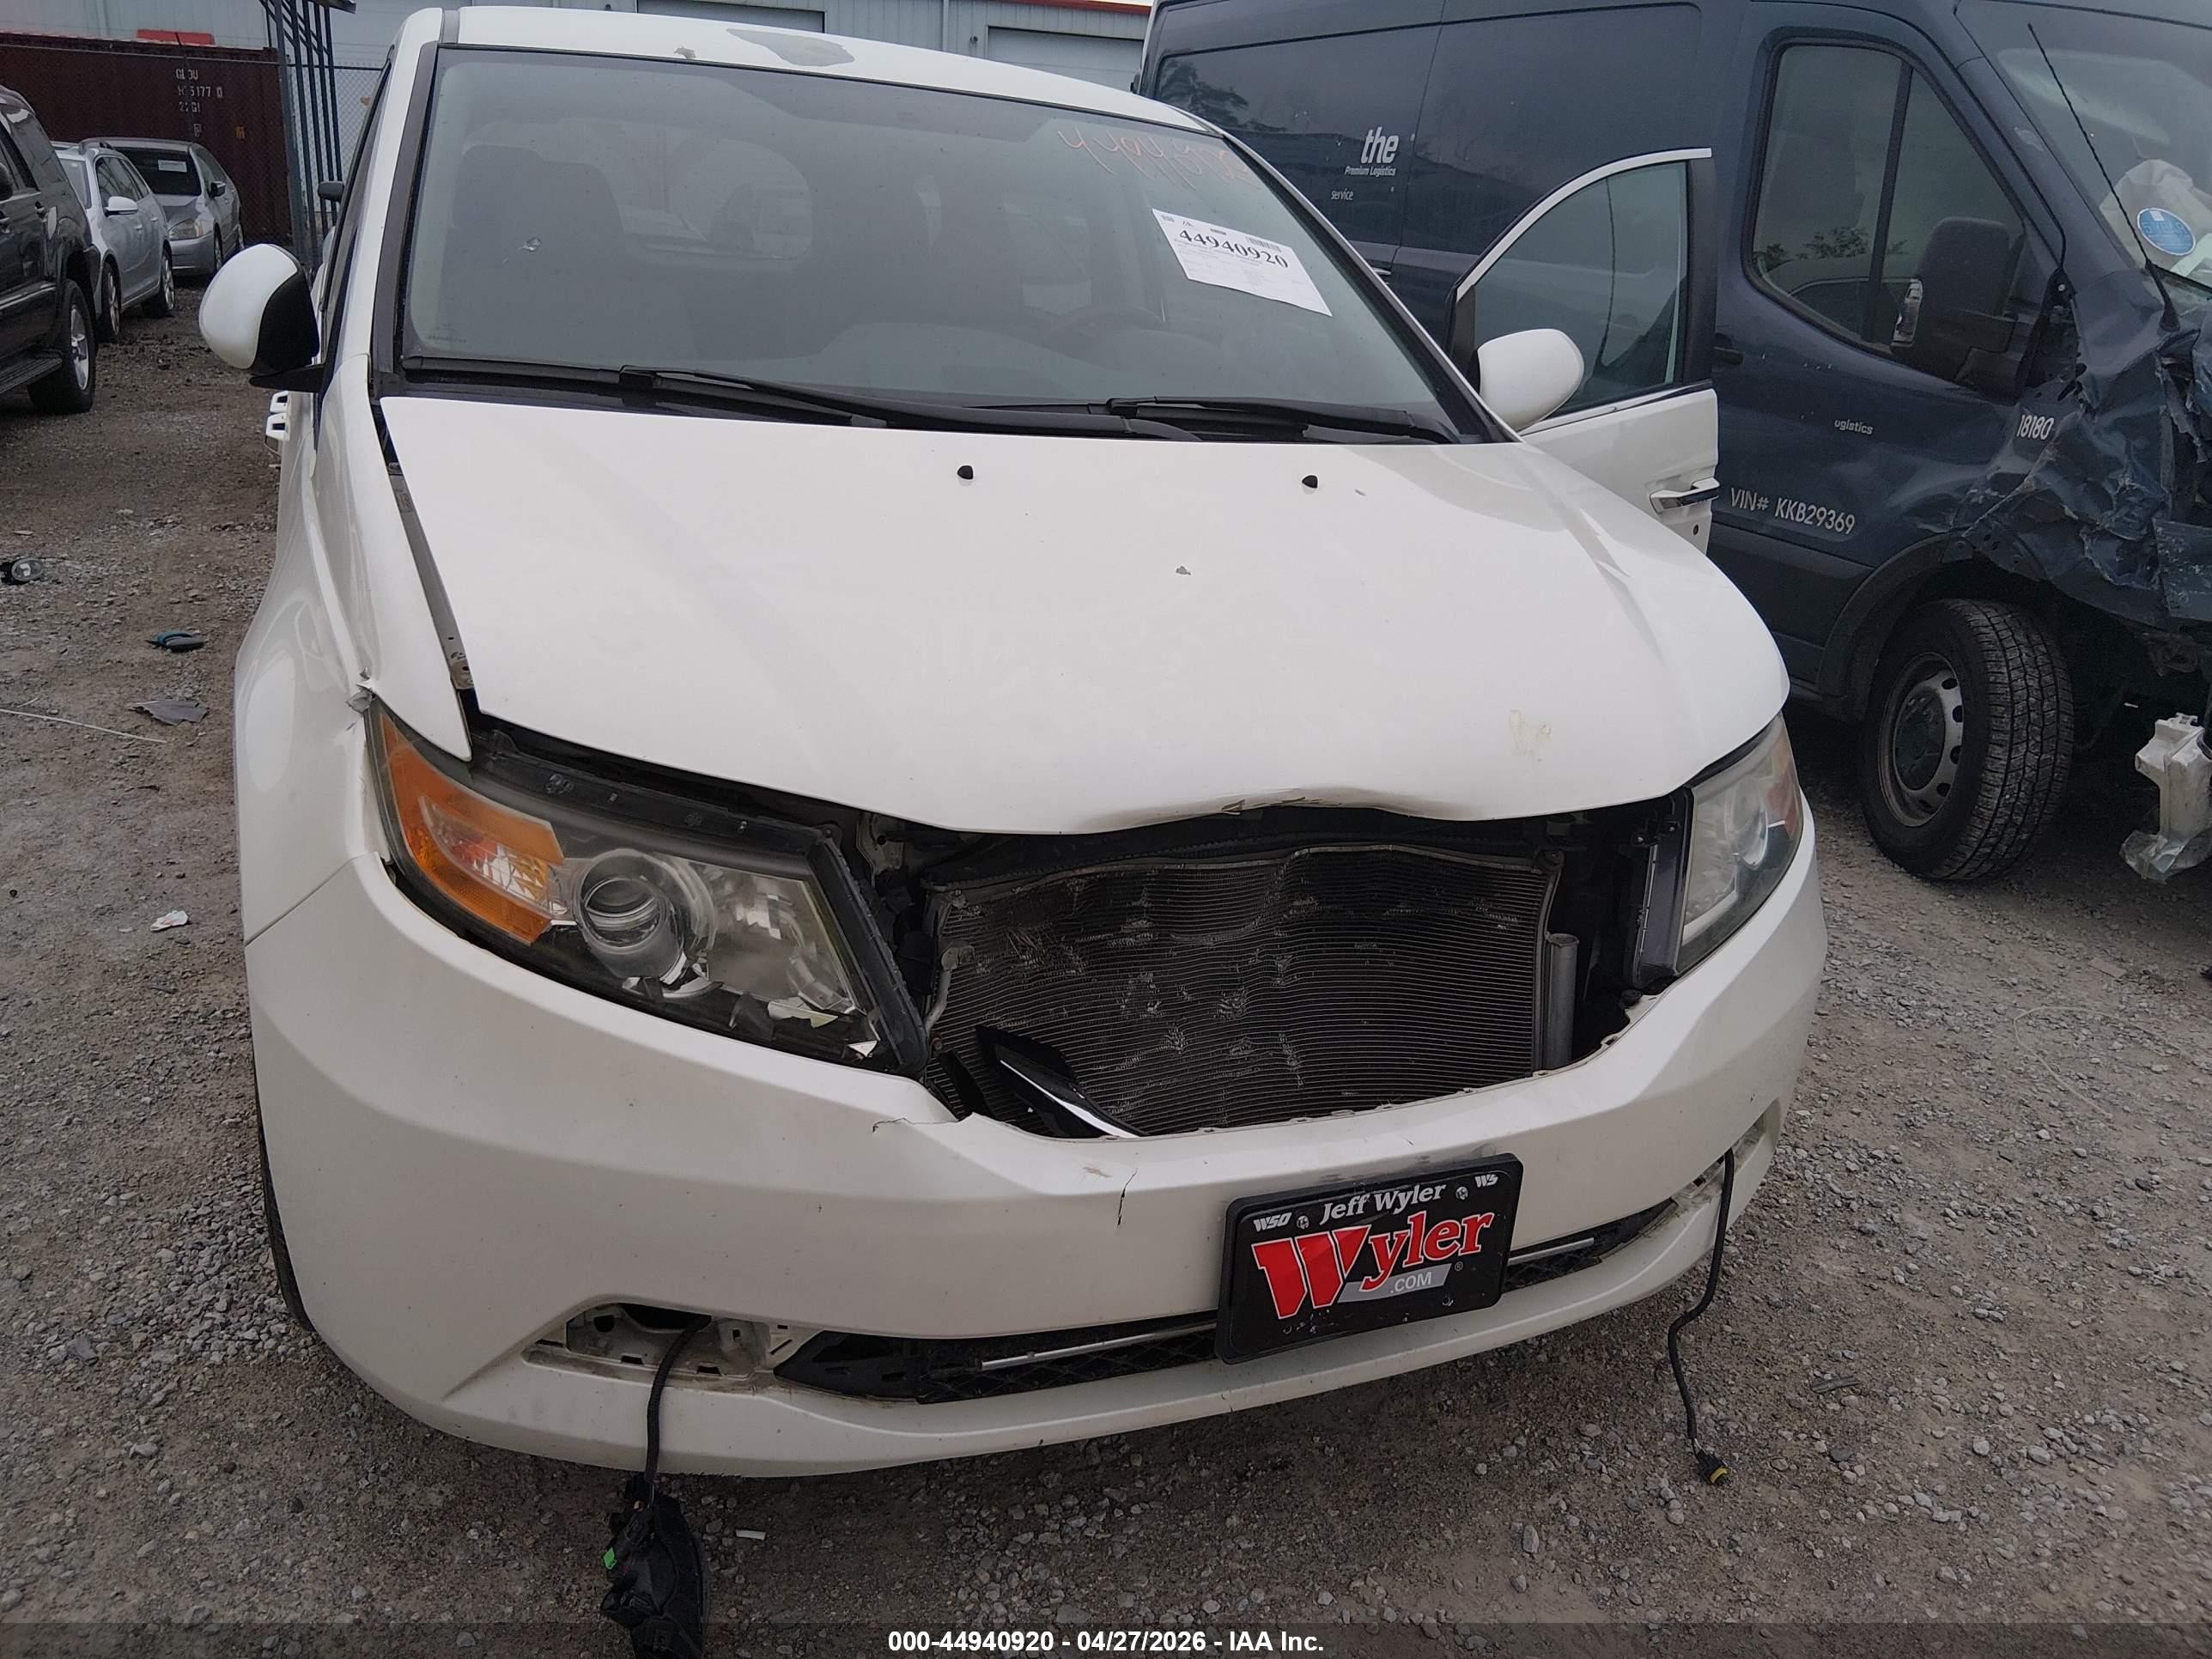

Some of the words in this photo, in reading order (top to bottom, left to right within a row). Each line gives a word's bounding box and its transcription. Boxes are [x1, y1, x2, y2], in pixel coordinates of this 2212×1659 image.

[1361, 126, 1399, 163] the
[1345, 166, 1370, 175] Premium
[1370, 166, 1396, 177] Logistics
[1331, 188, 1353, 200] service
[1180, 229, 1288, 268] 44940920
[2016, 414, 2054, 441] 18180
[1731, 488, 1769, 511] VIN#
[1774, 498, 1856, 536] KKB29369
[1320, 1194, 1368, 1224] Jeff
[1374, 1183, 1446, 1215] Wyler
[1251, 1211, 1495, 1320] Wyler
[1390, 1271, 1432, 1294] .COM
